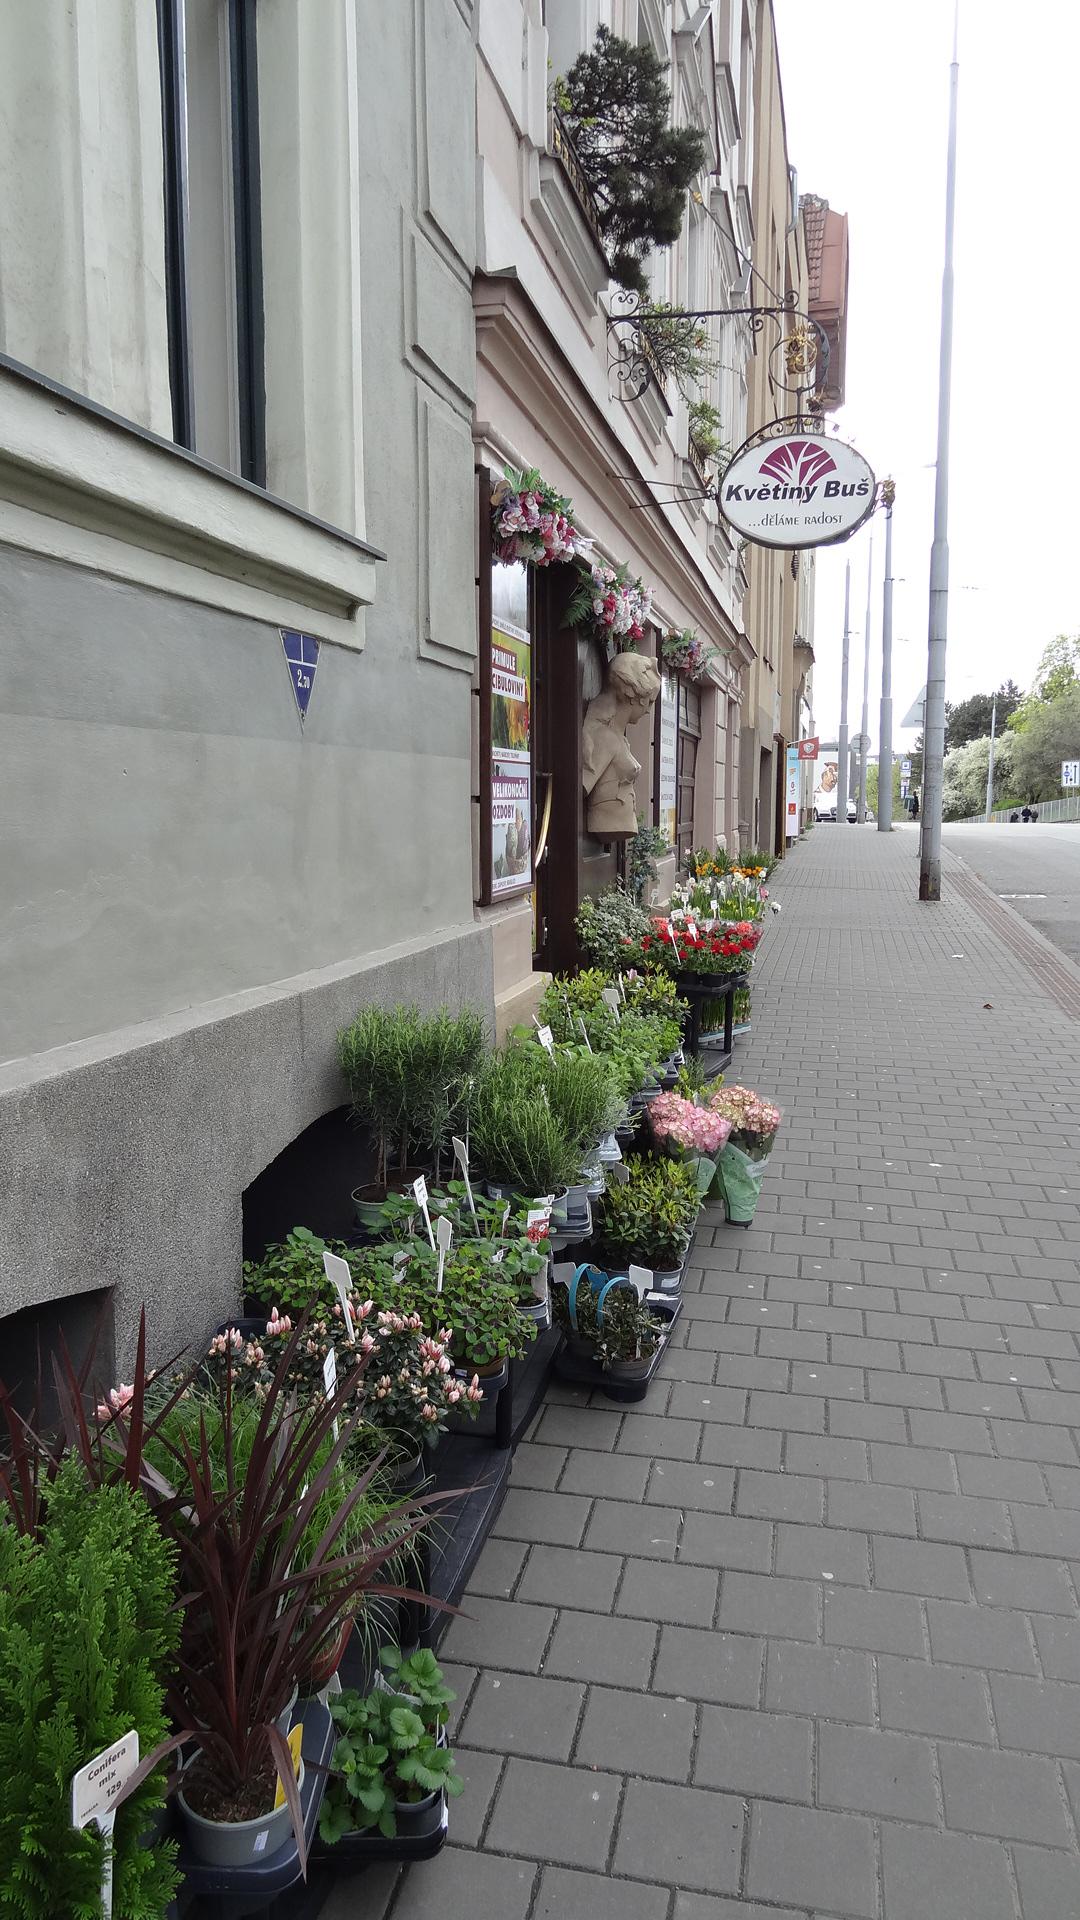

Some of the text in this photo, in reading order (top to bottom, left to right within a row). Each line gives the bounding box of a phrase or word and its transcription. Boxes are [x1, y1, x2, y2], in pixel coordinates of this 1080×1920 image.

[725, 478, 870, 503] Květiny Buš
[491, 648, 516, 671] PRIMULE
[491, 673, 524, 697] CIBULOVINY
[492, 779, 528, 798] VELIKONOČNÍ
[492, 803, 515, 820] OZDOBY
[88, 1748, 126, 1781] Conifera
[99, 1769, 117, 1788] mix
[106, 1780, 122, 1798] 129
